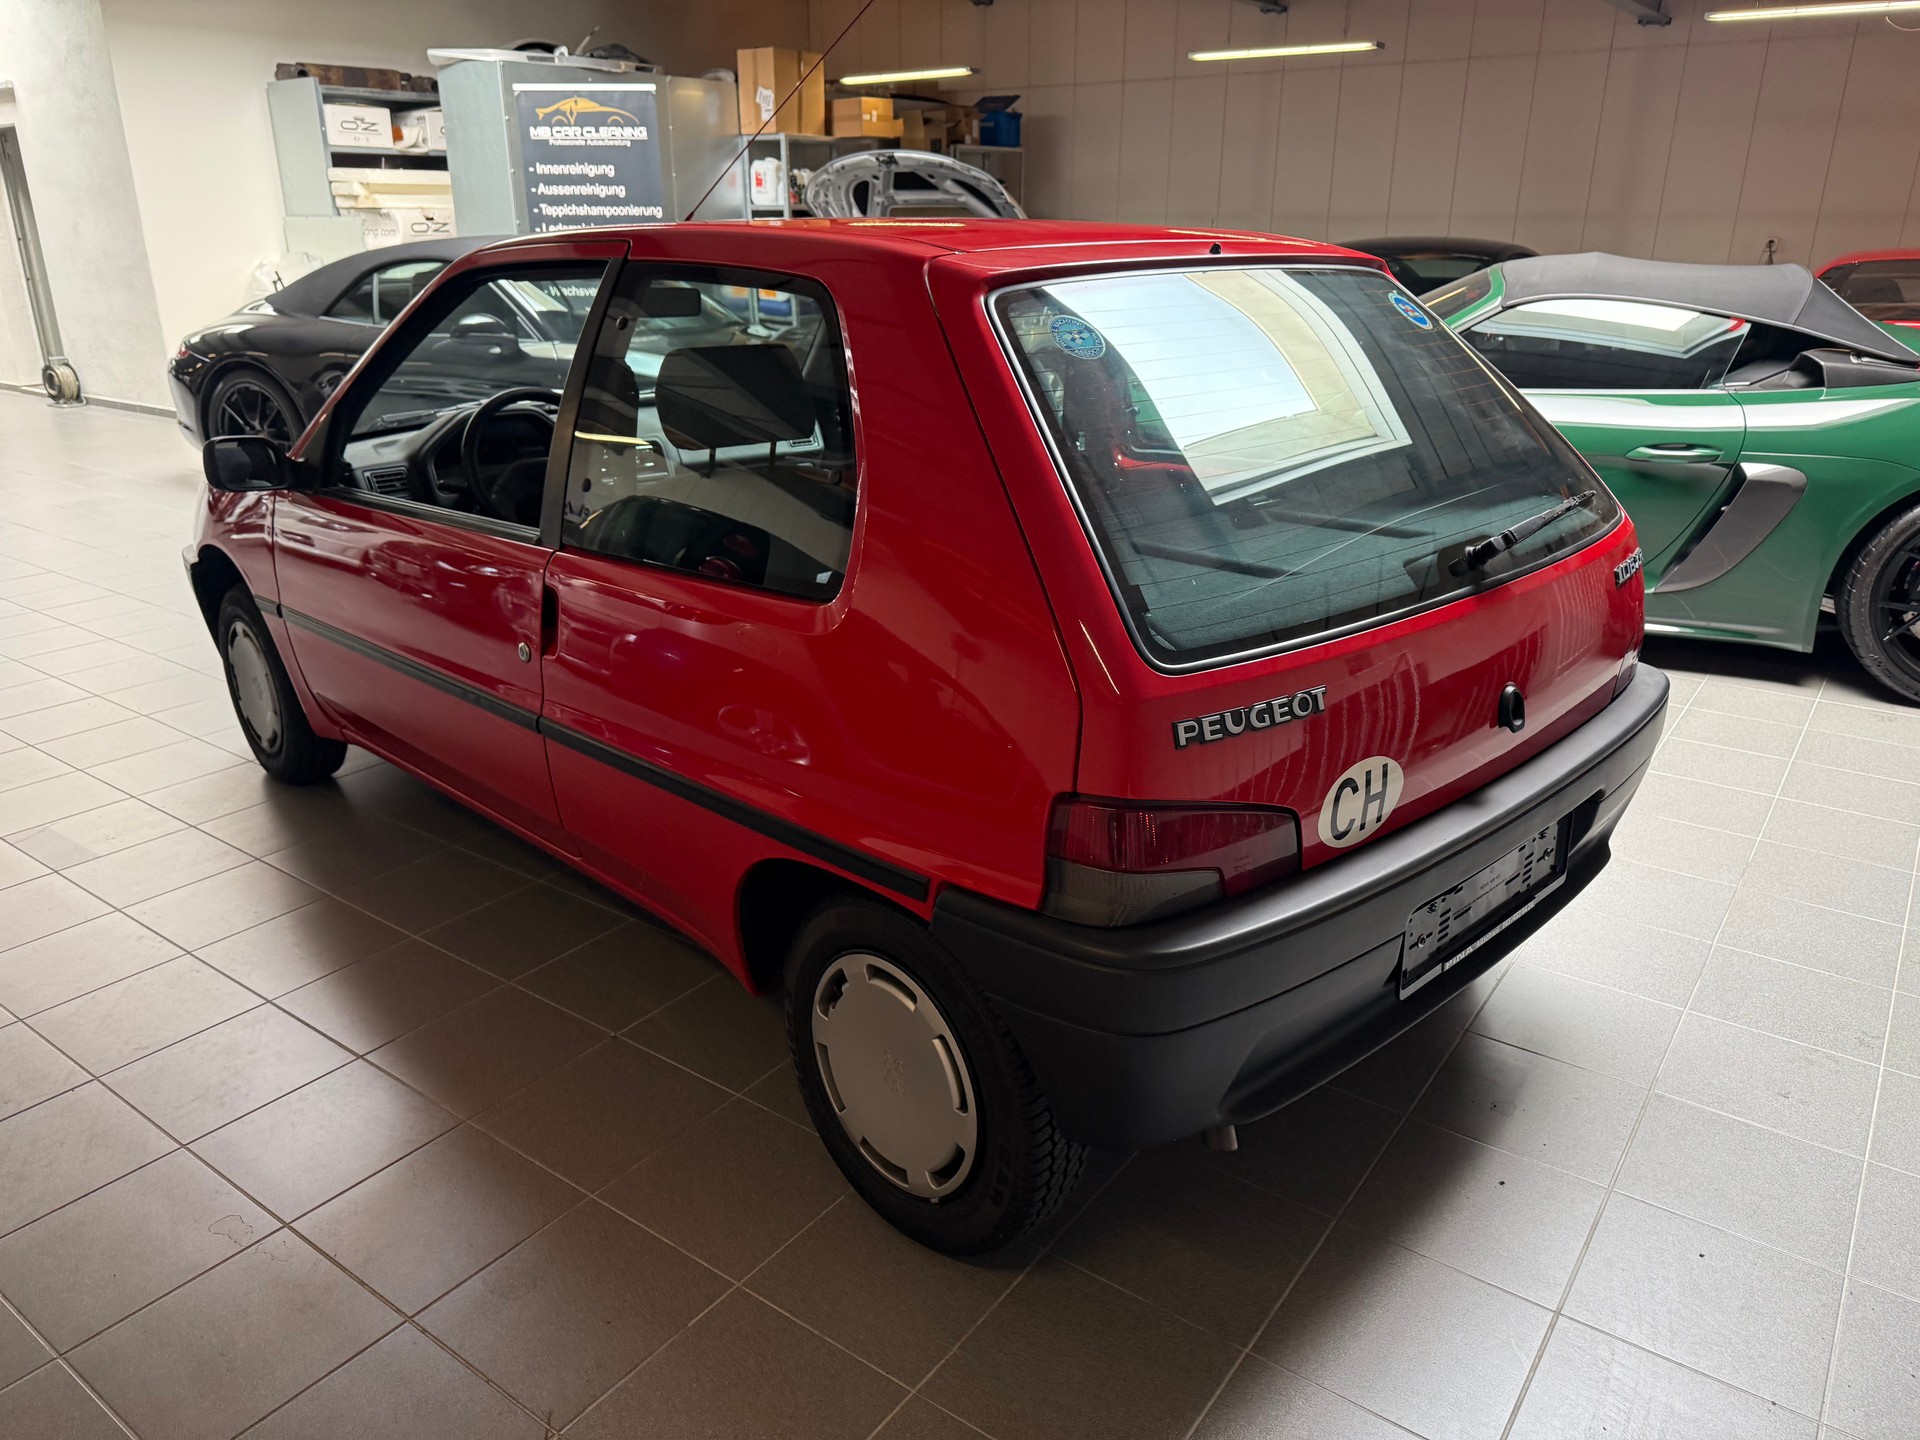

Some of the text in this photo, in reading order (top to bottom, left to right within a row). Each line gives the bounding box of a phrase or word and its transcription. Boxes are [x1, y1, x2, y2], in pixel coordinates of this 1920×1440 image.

[529, 126, 648, 139] MB CAR CLEANING
[536, 162, 615, 177] Innenreinigung
[538, 183, 626, 198] Aussenreinigung
[539, 203, 663, 218] Teppichshampoonierung
[1173, 685, 1327, 748] PEUGEOT
[1330, 763, 1388, 841] CH
